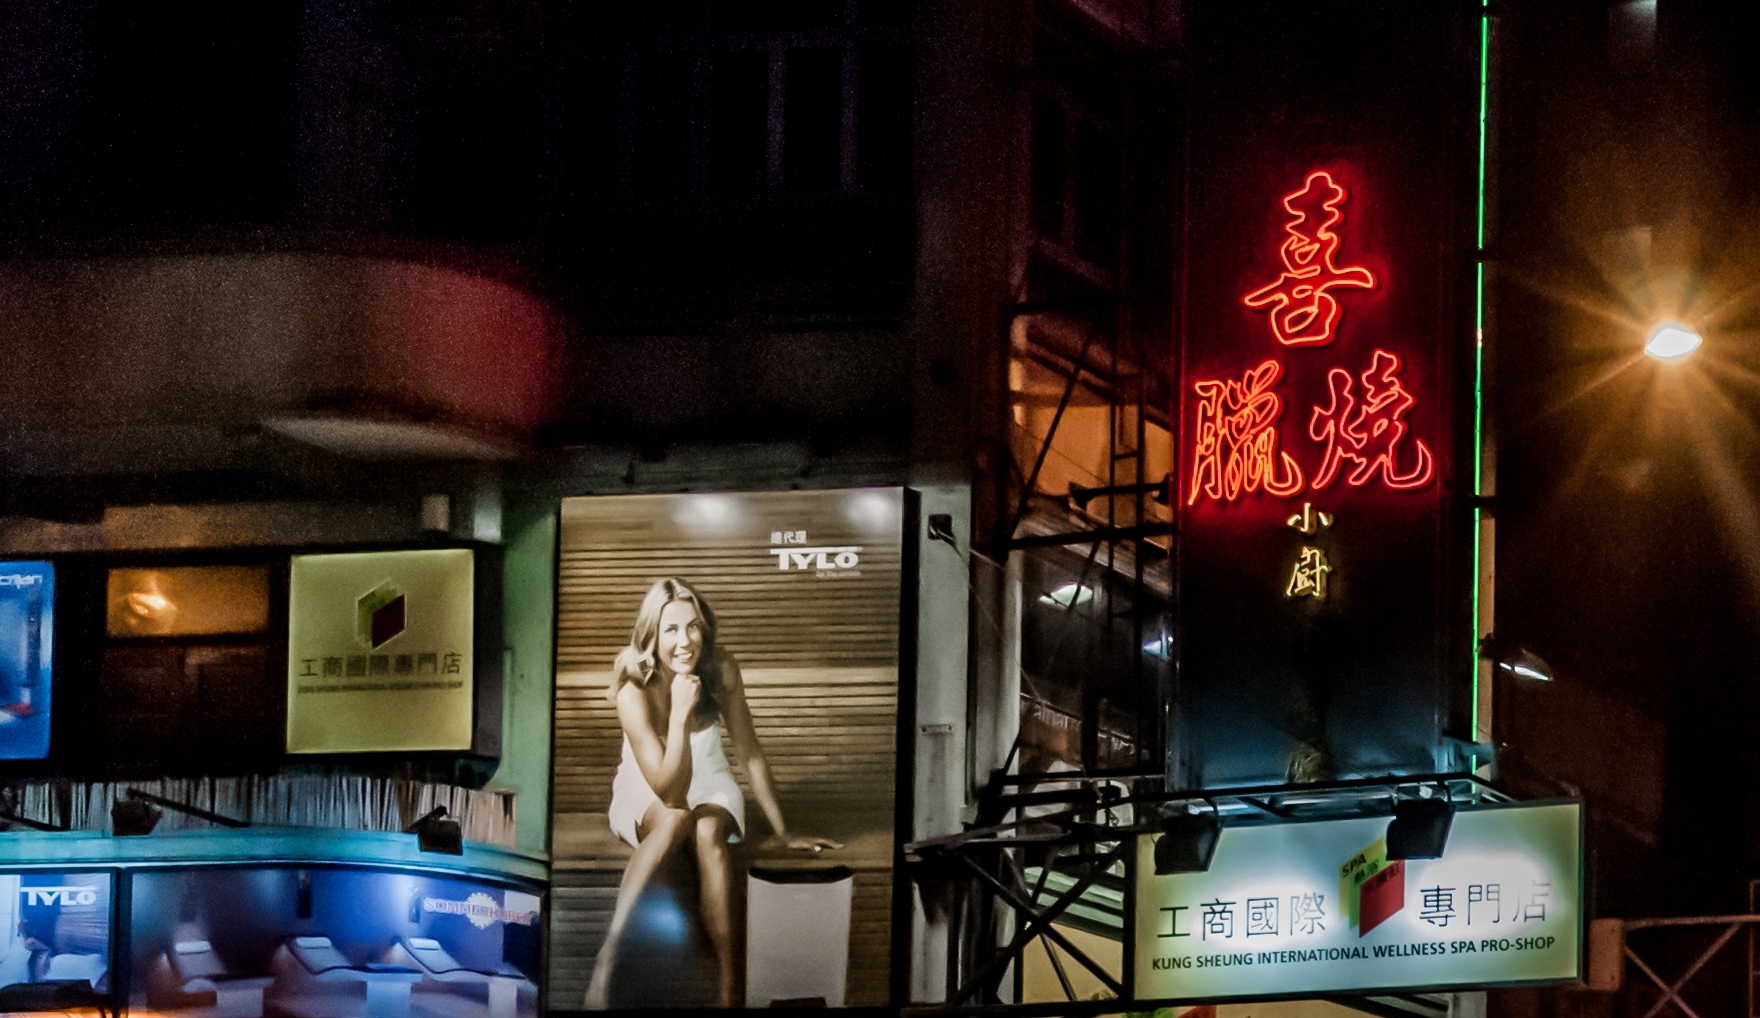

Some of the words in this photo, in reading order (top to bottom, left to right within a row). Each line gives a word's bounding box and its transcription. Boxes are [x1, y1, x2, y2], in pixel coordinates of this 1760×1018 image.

[1244, 171, 1377, 347] 喜
[1157, 891, 1326, 942] 工商國際
[1419, 879, 1552, 928] 專門店
[1152, 957, 1192, 970] KUNG
[1196, 953, 1253, 969] SHEUNG
[1257, 946, 1369, 964] INTERNATIONAL
[1373, 942, 1446, 958] WELLNESS
[1450, 940, 1476, 954] SPA
[1481, 936, 1556, 952] PRO-SHOP
